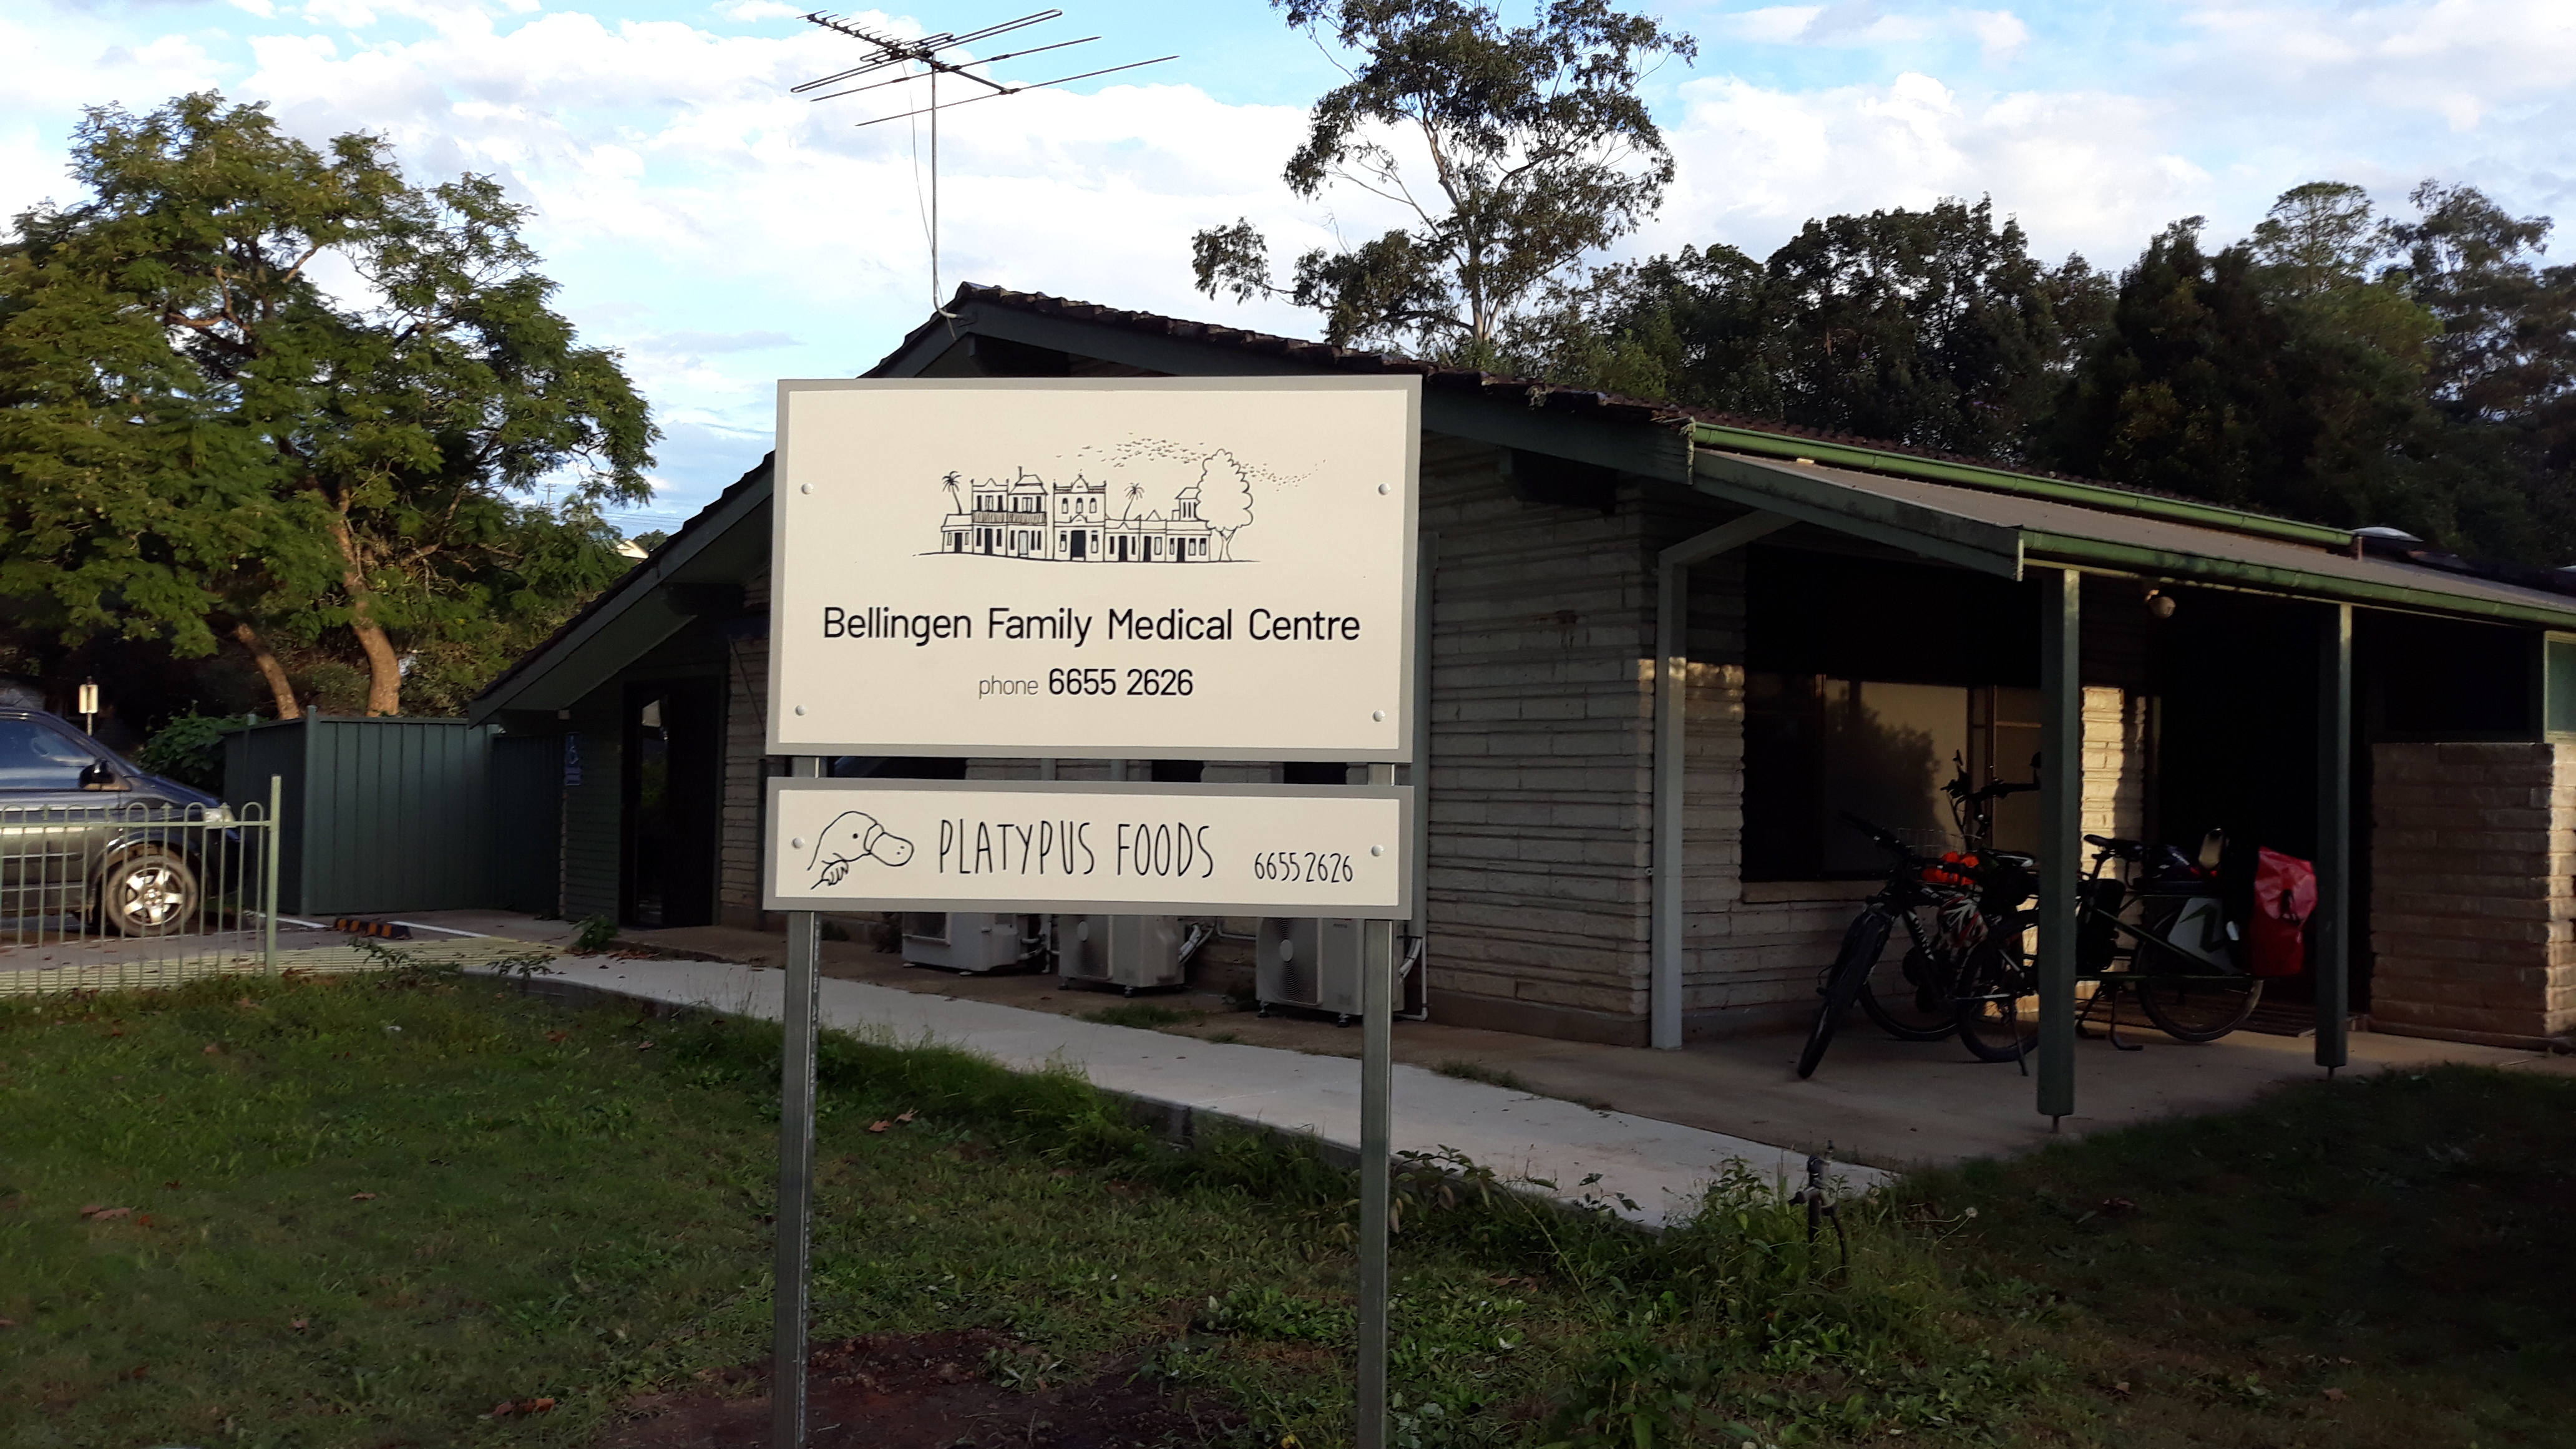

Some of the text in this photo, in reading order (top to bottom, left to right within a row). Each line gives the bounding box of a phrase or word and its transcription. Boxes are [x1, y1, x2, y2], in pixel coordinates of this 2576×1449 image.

[824, 607, 1360, 647] Bellingen Family Medical Centre
[979, 668, 1193, 699] phone 6655 2626
[939, 819, 1213, 878] PLATYPUS FOODS
